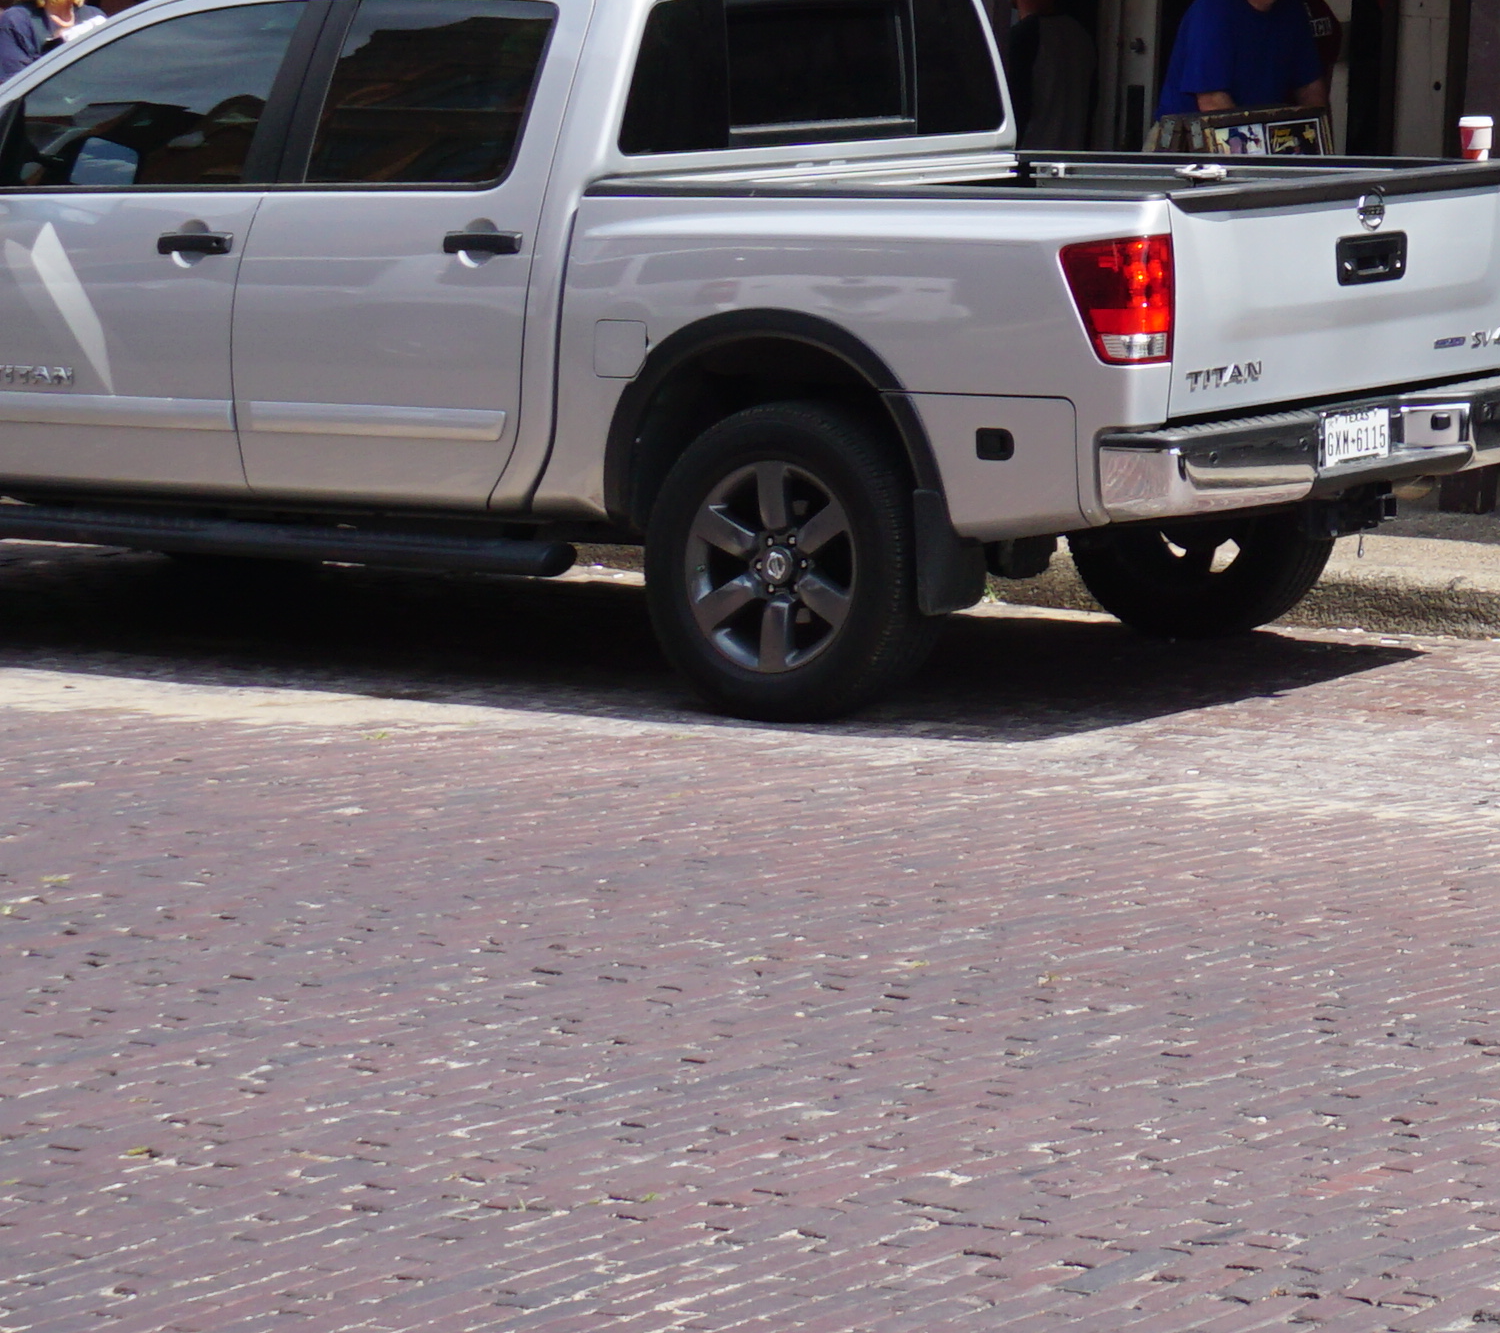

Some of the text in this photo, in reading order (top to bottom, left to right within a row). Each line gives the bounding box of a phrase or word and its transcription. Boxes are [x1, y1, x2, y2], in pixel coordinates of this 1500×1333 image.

[1471, 331, 1492, 349] SV
[0, 365, 75, 386] ITAN
[1186, 361, 1262, 393] TITAN
